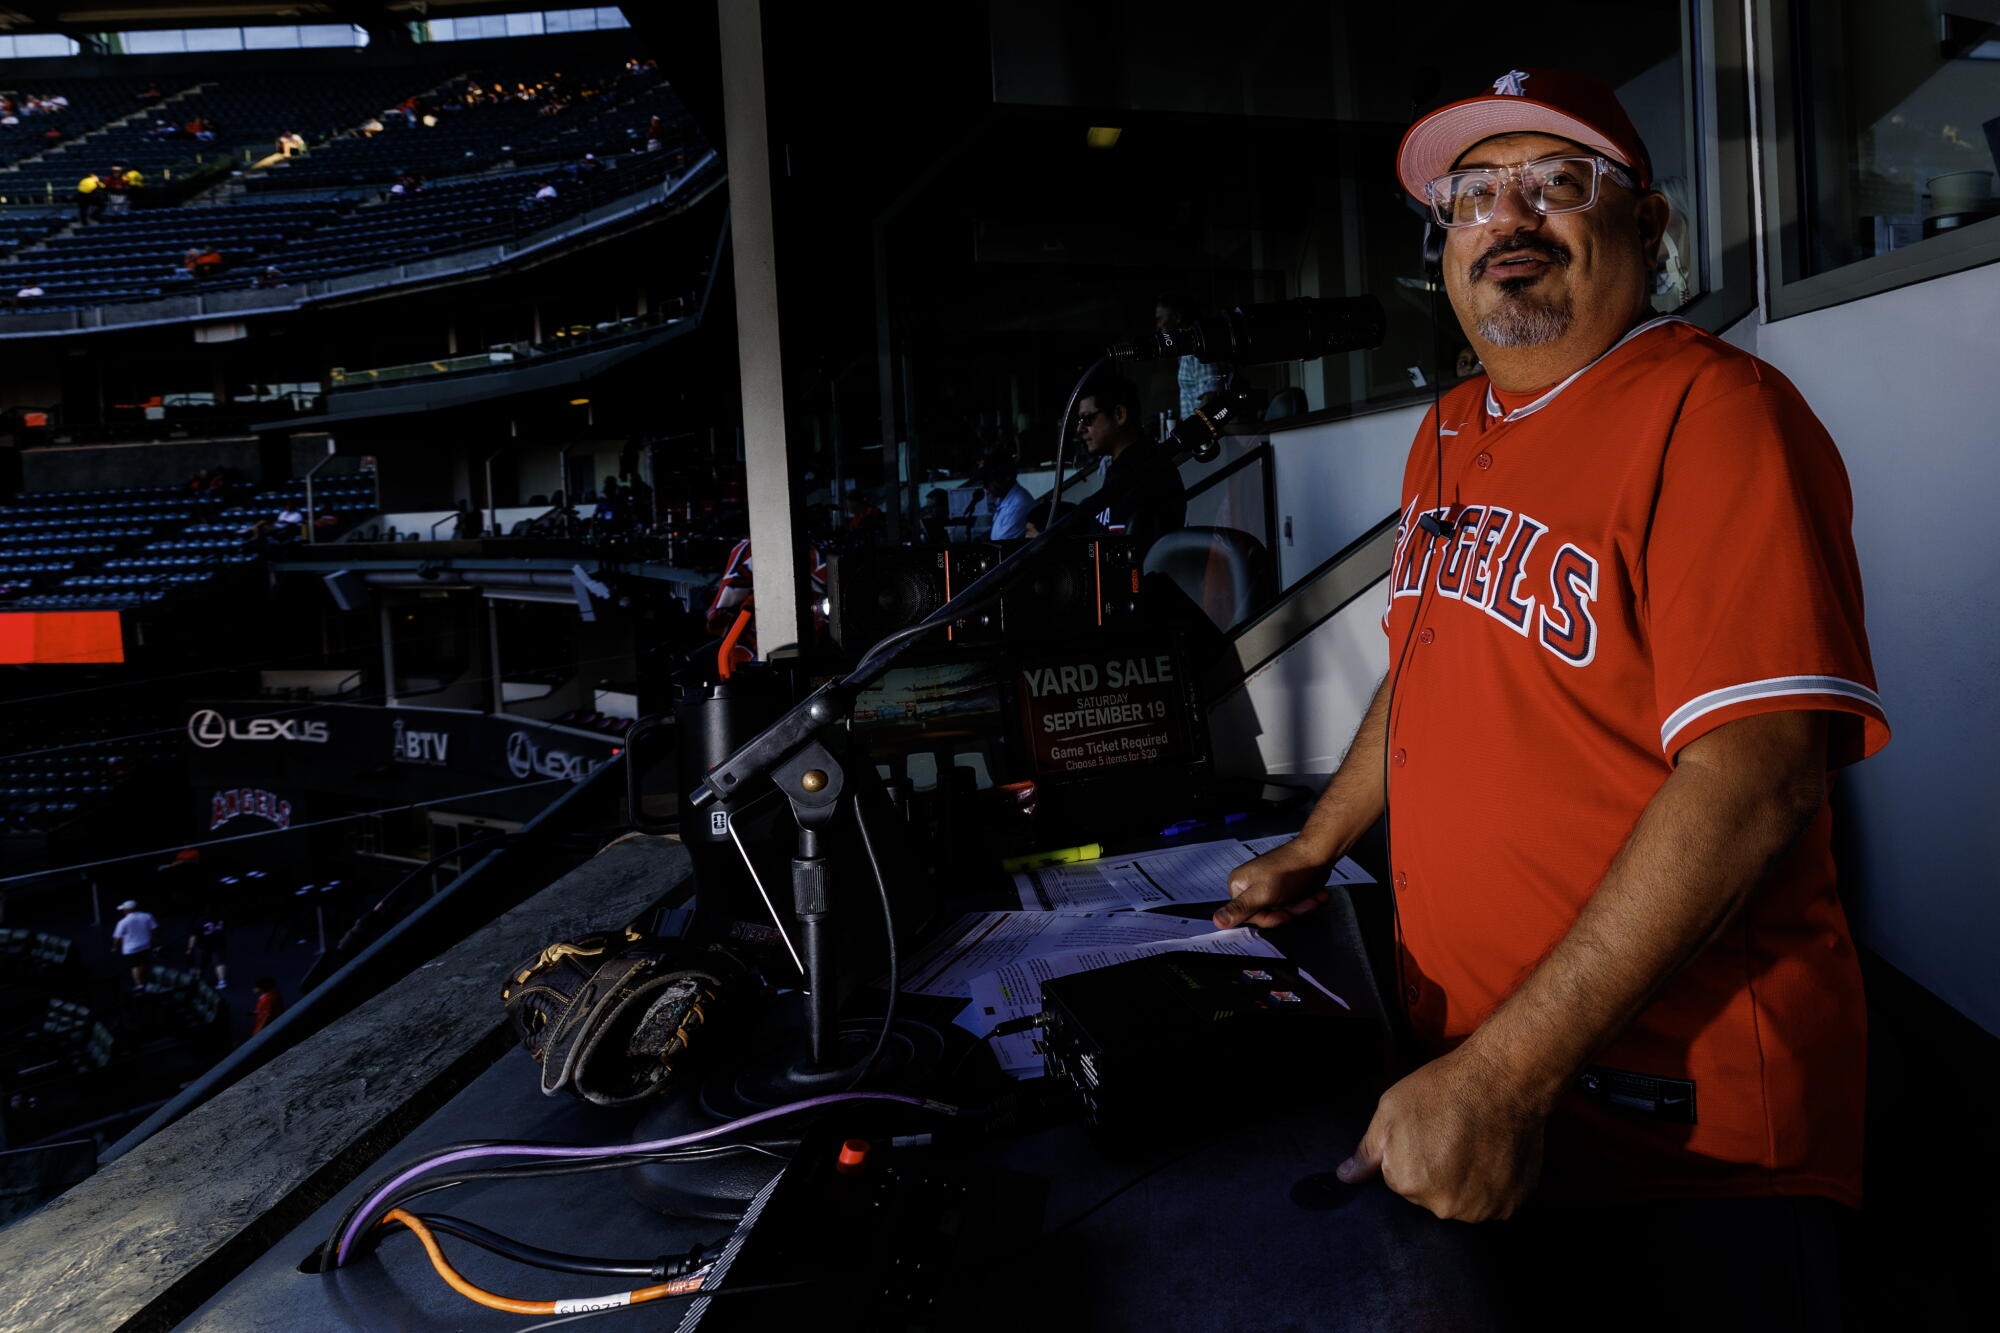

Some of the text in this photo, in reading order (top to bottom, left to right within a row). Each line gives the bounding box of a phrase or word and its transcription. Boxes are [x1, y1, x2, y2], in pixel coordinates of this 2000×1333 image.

[1023, 655, 1174, 697] YARD SALE
[1077, 693, 1129, 709] SATURDAY
[1042, 700, 1166, 733] SEPTEMBER 19
[228, 718, 329, 744] LEXUS
[1051, 732, 1168, 760] Game Ticket Required
[1065, 748, 1158, 771] Choose 5 items for $20
